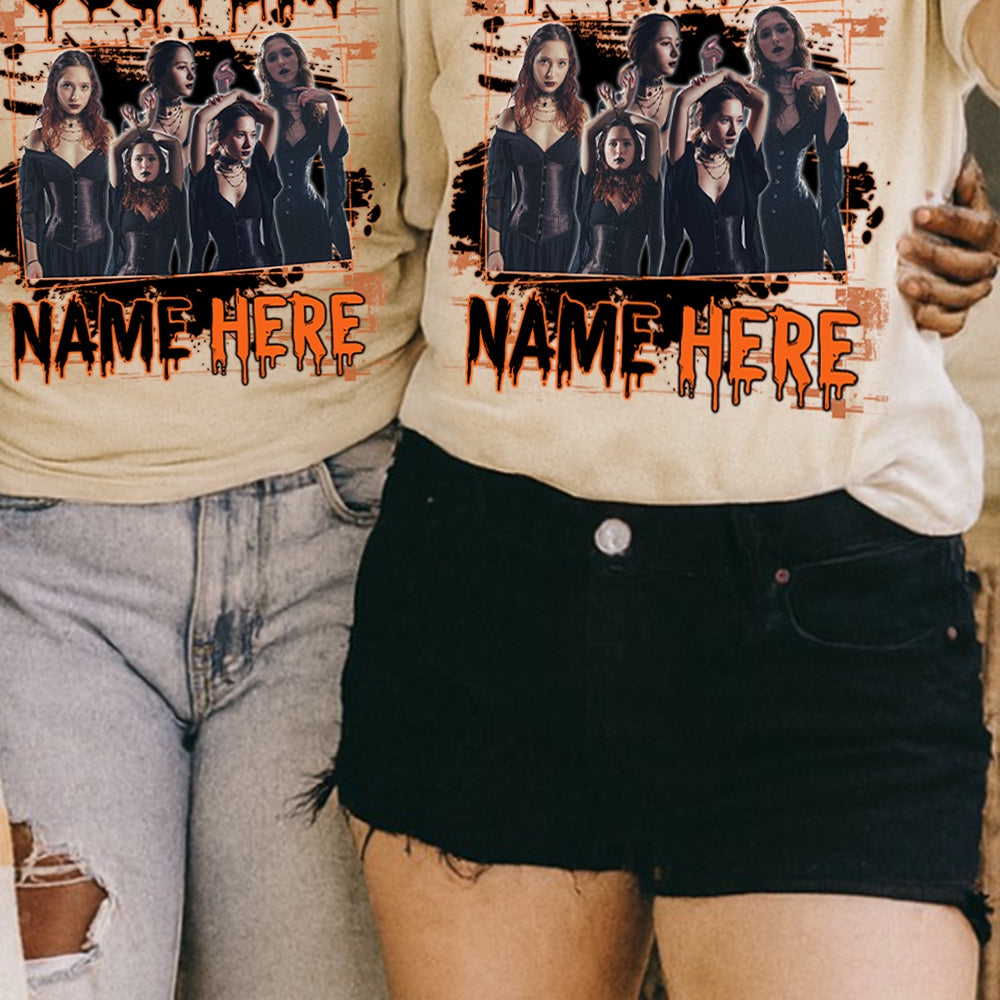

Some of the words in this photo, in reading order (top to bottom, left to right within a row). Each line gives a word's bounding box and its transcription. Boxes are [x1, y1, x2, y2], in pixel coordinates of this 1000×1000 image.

[10, 292, 194, 385] NAME
[209, 288, 367, 386] HERE
[464, 290, 662, 400] NAME
[676, 294, 863, 413] HERE
